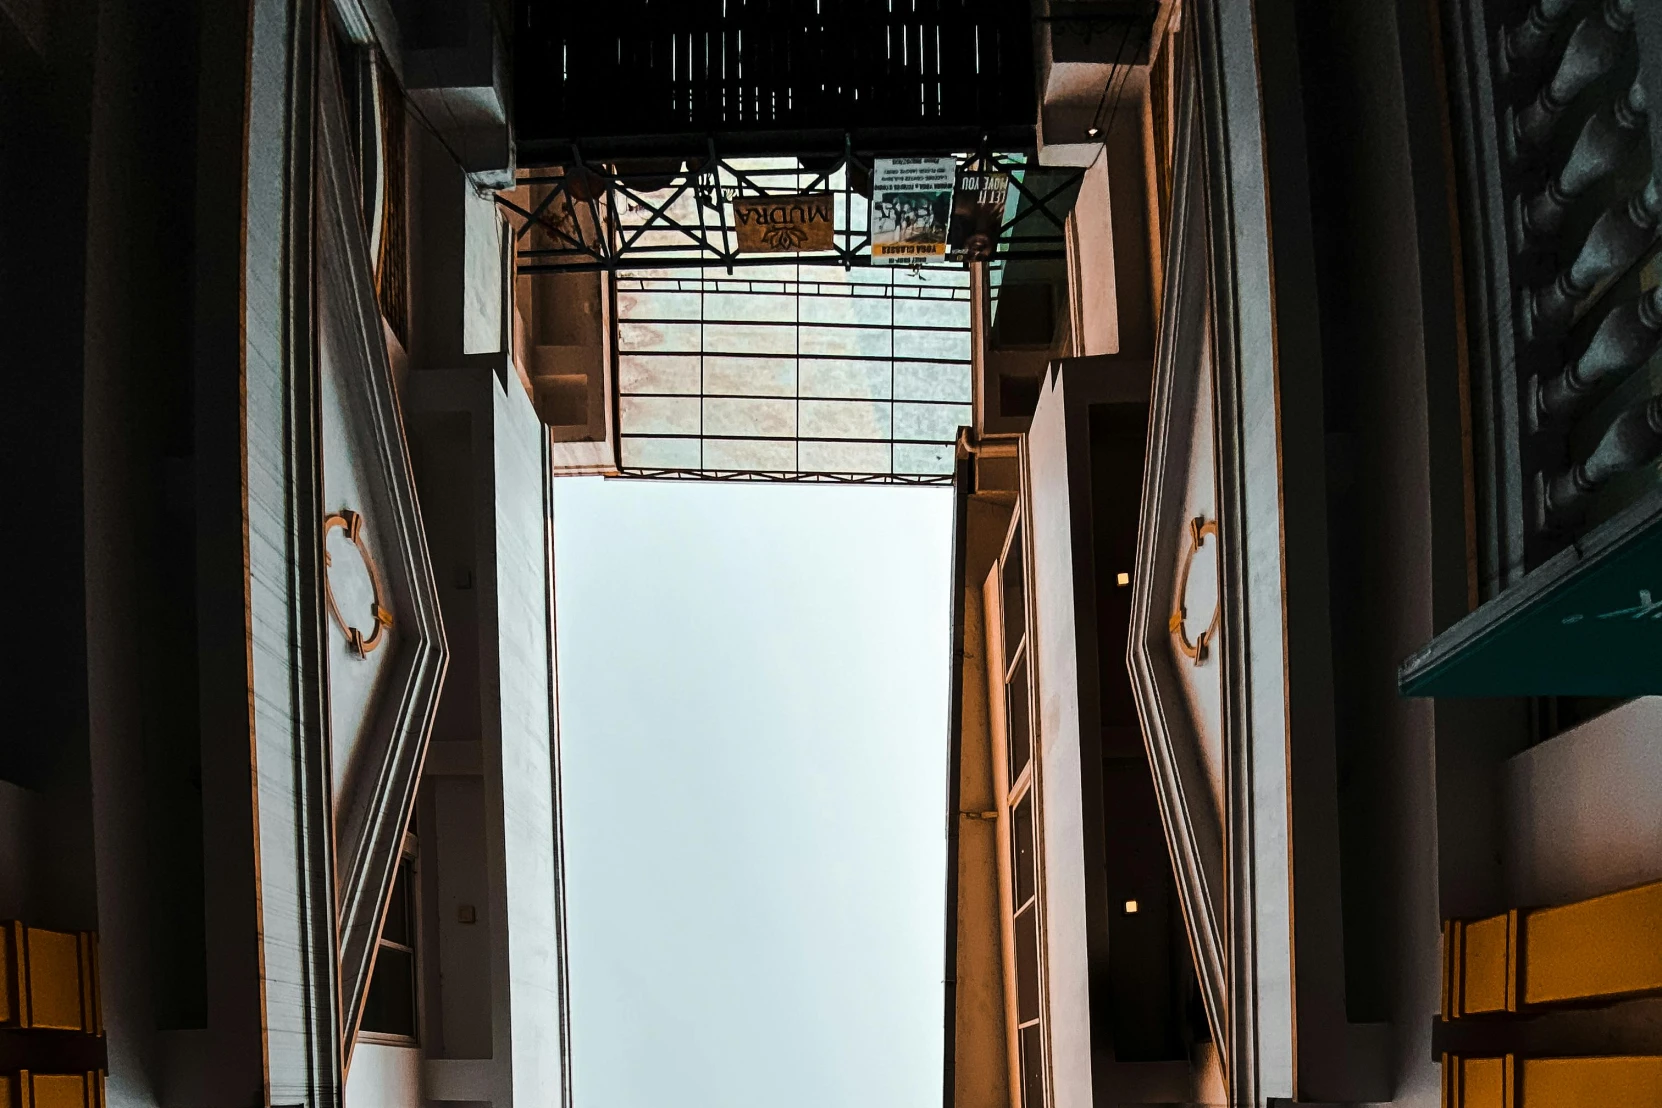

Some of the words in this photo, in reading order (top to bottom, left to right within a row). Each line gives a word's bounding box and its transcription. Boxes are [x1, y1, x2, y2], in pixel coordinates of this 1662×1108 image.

[962, 177, 979, 190] YOU
[983, 177, 1008, 190] MOVE
[977, 191, 987, 204] IT
[989, 191, 1006, 204] LET
[736, 206, 830, 226] MUDRA
[882, 246, 915, 254] CLASSES
[917, 245, 937, 254] YOGA
